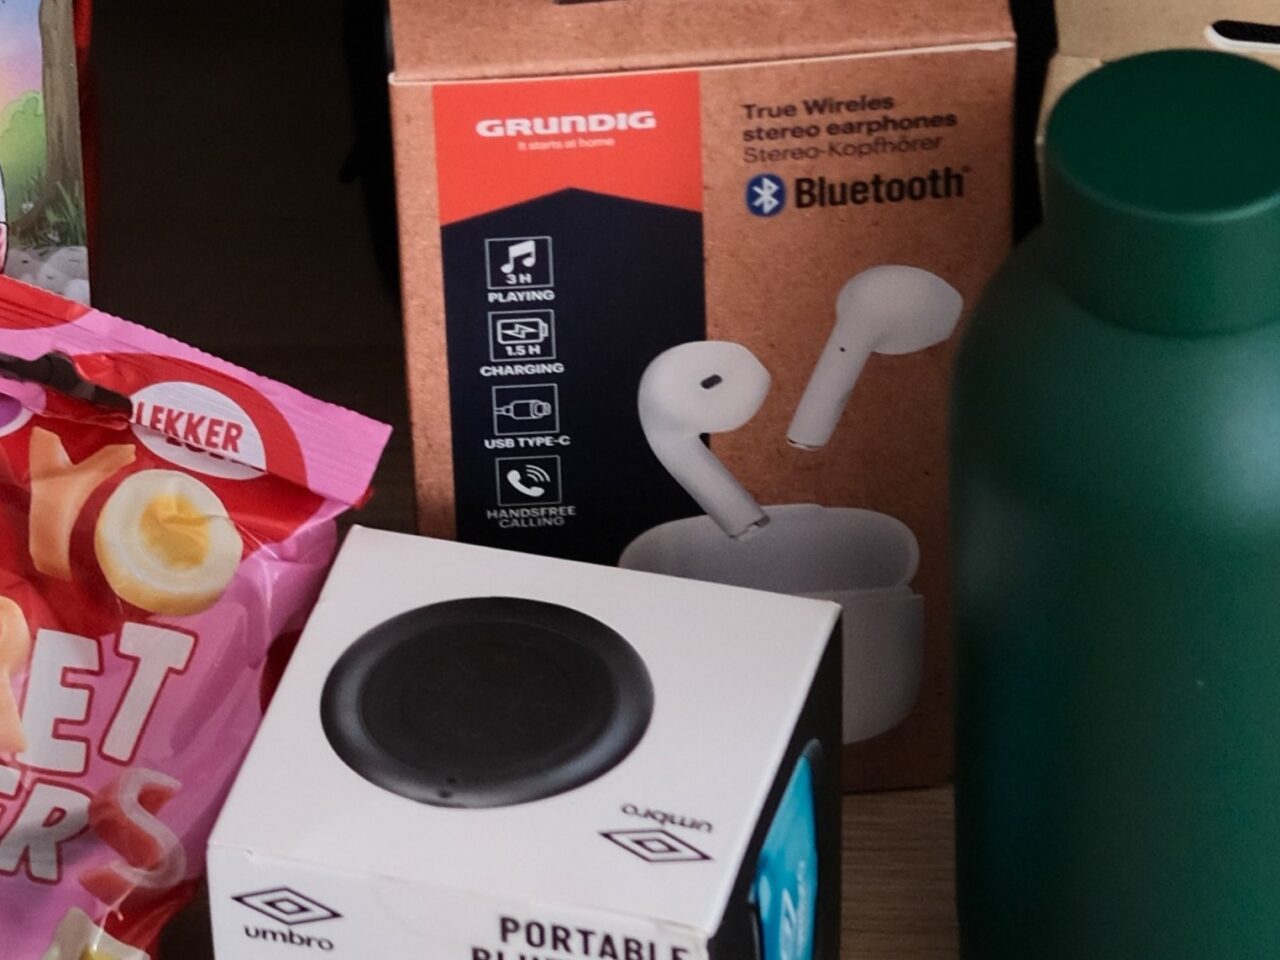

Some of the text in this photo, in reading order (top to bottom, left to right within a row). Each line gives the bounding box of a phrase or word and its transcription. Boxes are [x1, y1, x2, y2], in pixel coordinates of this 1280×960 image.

[742, 103, 798, 121] True
[476, 111, 657, 137] GRUNDIG
[743, 112, 958, 143] stereo earphones
[578, 137, 616, 148] home
[795, 166, 965, 209] Bluetooth
[505, 272, 532, 285] 3 H
[487, 289, 556, 303] PLAYING
[505, 344, 541, 357] 1.5 H
[479, 362, 565, 377] CHARGING
[135, 401, 243, 453] LEKKER
[484, 435, 571, 449] USB TYPE-C
[486, 506, 577, 520] HANDSFREE
[499, 516, 565, 529] CALLING
[621, 803, 713, 833] umbro
[243, 924, 336, 952] umbro
